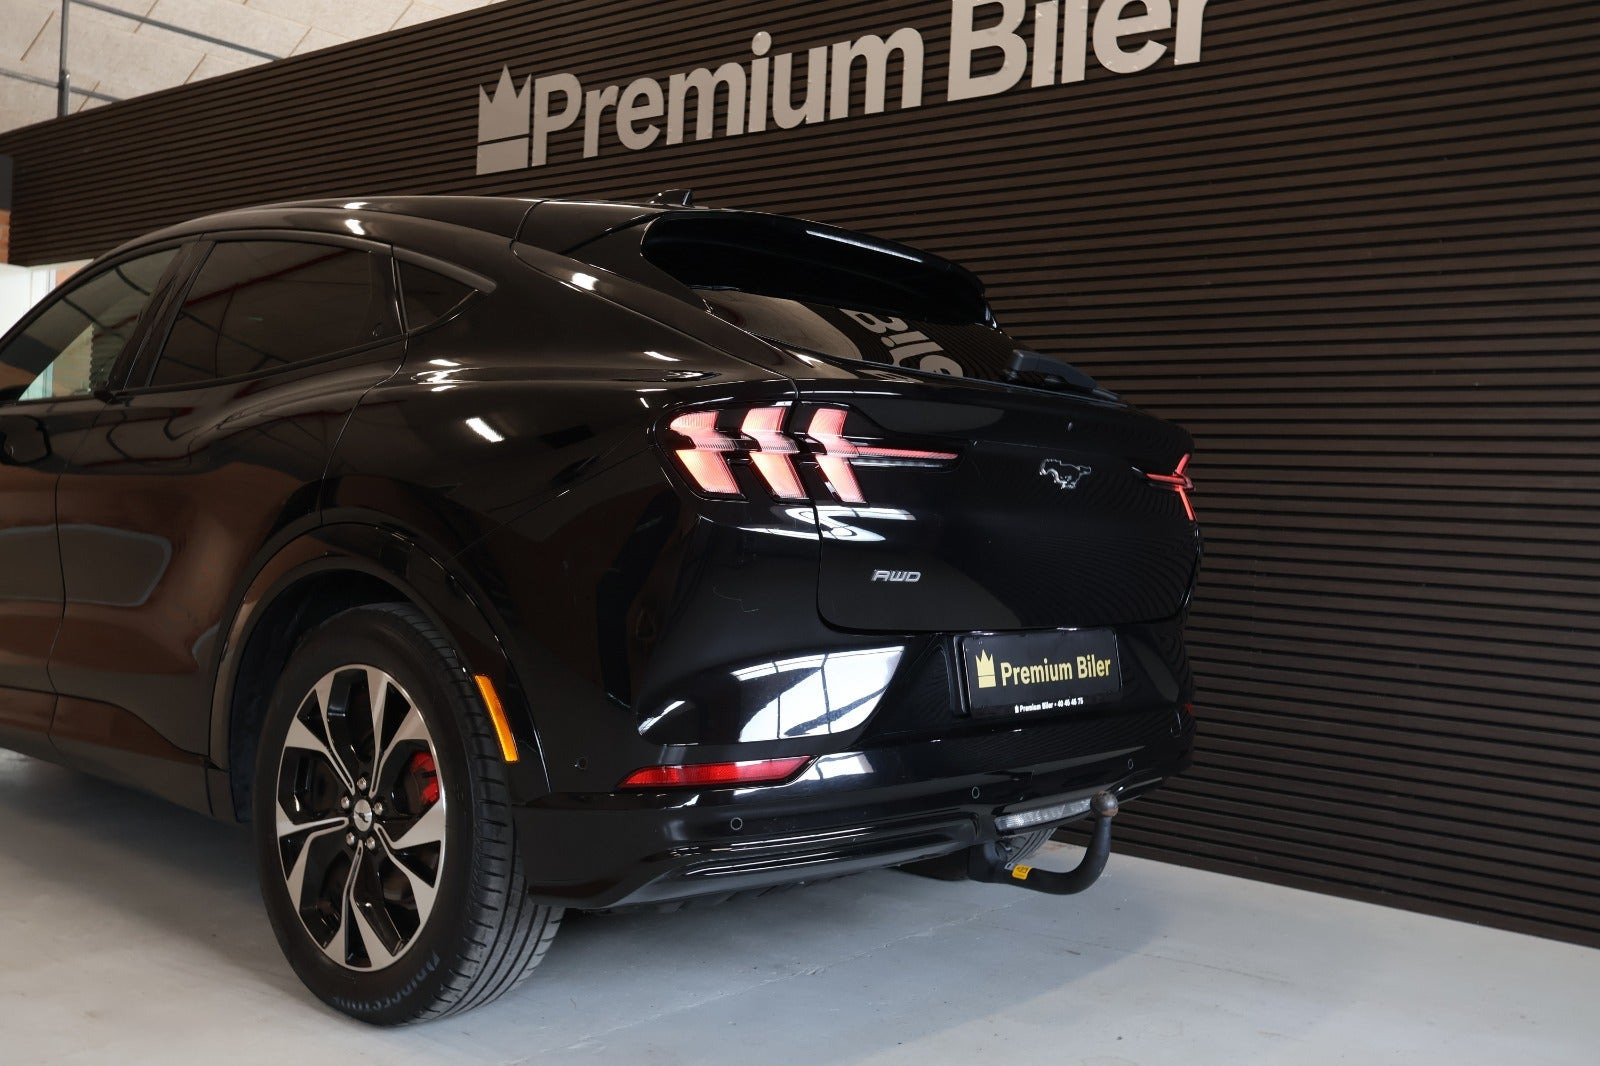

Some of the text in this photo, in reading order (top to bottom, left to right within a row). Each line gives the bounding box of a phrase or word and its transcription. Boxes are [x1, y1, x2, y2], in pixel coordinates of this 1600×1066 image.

[531, 27, 924, 167] Premium
[871, 569, 922, 582] AWD
[1000, 653, 1111, 687] Premium Biler
[1019, 703, 1041, 713] Premium
[1041, 701, 1054, 710] Biler
